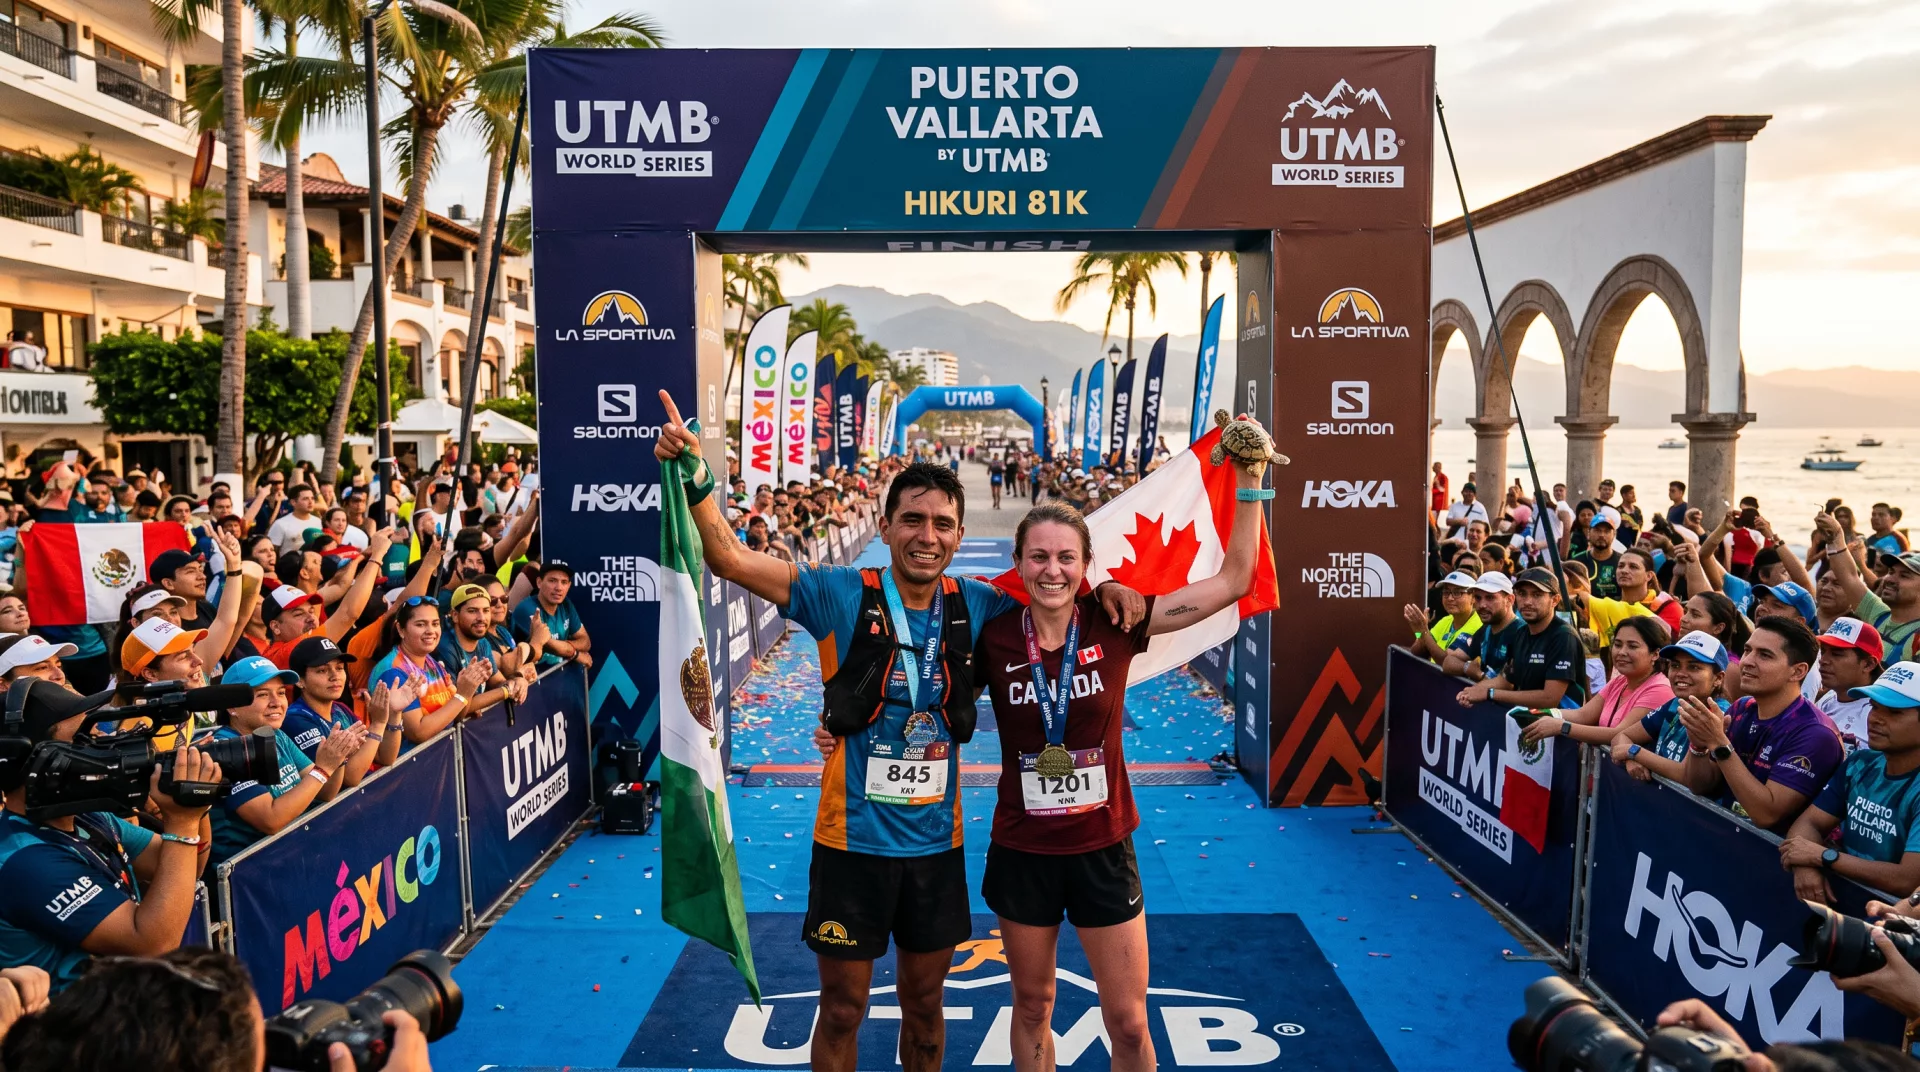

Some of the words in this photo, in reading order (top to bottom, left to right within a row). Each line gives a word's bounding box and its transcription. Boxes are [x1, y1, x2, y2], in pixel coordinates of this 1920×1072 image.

[911, 65, 1079, 99] PUERTO
[885, 106, 1104, 139] VALLARTA
[563, 153, 636, 169] WORLD
[643, 157, 705, 172] SERIES
[937, 149, 957, 161] BY
[962, 148, 1048, 173] UTMB
[1281, 168, 1339, 182] WORLD
[1344, 170, 1395, 184] SERIES
[904, 190, 1016, 216] HIKURI
[1027, 190, 1089, 215] 81K
[886, 240, 1092, 252] FINISH
[555, 329, 579, 342] LA
[582, 328, 676, 341] SPORTIVA
[1291, 326, 1315, 339] LA
[1318, 326, 1410, 338] SPORTIVA
[944, 391, 996, 406] UTMB
[839, 393, 853, 448] UTMB
[1087, 387, 1101, 452] HOKA
[1112, 392, 1129, 449] UTMB
[571, 484, 662, 512] HOKA
[1301, 480, 1397, 508] HOKA
[600, 556, 635, 571] THE
[1328, 553, 1363, 567] THE
[574, 572, 636, 587] NORTH
[1302, 568, 1363, 583] NORTH
[591, 587, 636, 602] FACE
[1318, 584, 1363, 598] FACE
[1008, 670, 1105, 705] CANDA
[501, 711, 567, 798] UTMB
[887, 765, 931, 783] 845
[1038, 773, 1091, 794] 1201
[510, 791, 542, 830] WORLD
[543, 772, 567, 807] SERIES
[1855, 796, 1893, 819] PUERTO
[1423, 776, 1463, 818] WORLD
[1466, 809, 1508, 852] SERIES
[1847, 802, 1897, 837] VALLARTA
[45, 876, 93, 914] UTMB
[819, 935, 858, 946] SPORTIVA
[1624, 851, 1845, 1046] HOKA
